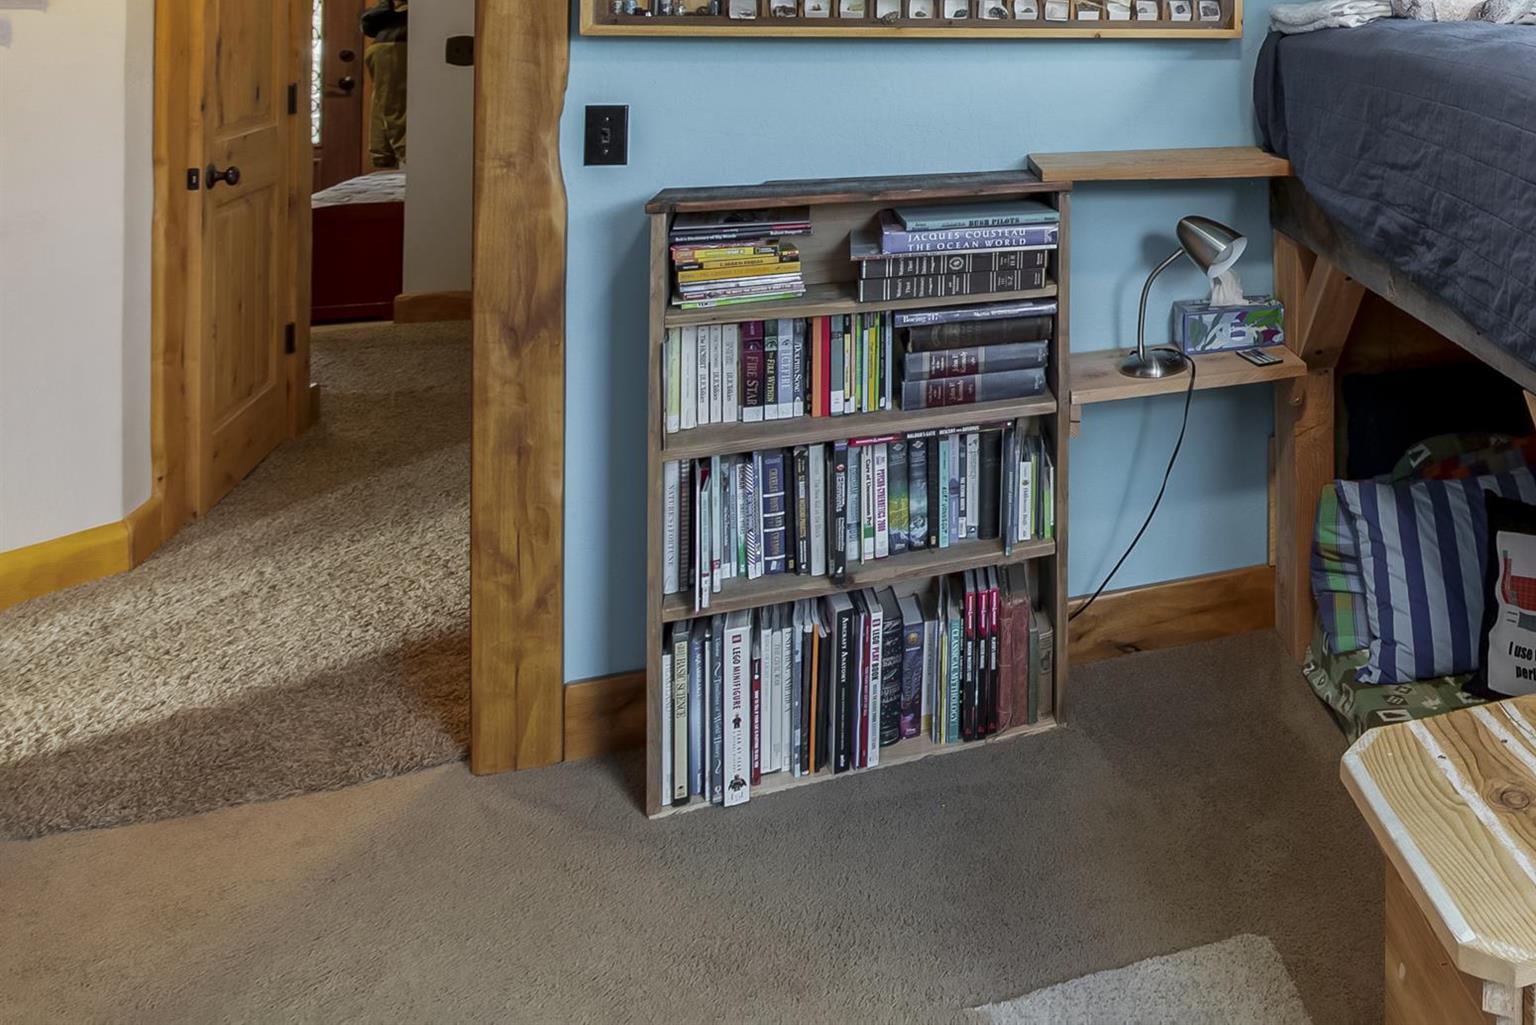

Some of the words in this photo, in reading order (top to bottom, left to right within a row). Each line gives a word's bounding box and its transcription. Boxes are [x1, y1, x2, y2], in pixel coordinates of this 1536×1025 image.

[907, 243, 932, 252] THE
[936, 240, 980, 251] OCEAN
[984, 237, 1027, 248] WORLD
[908, 231, 960, 243] JACQUES
[965, 228, 1027, 240] COUSTEAU
[746, 356, 758, 379] FIRE
[767, 358, 776, 374] FIRE
[781, 350, 792, 387] ICEFIRE
[746, 379, 758, 406] STAR
[767, 375, 775, 403] WITHIN
[841, 616, 849, 650] AIRCRAFT
[871, 629, 881, 645] LEGO
[732, 645, 742, 665] LEGO
[871, 646, 881, 662] PLAY
[950, 627, 960, 669] CLASSICAL
[1508, 640, 1514, 656] I
[1514, 643, 1533, 661] use
[675, 656, 686, 683] BASIC
[840, 650, 849, 683] ANATOMY
[871, 663, 881, 681] BOOK
[675, 682, 687, 719] SCIENCE
[732, 665, 742, 710] MINIFIGURE
[950, 672, 959, 723] MYTHOLOGY
